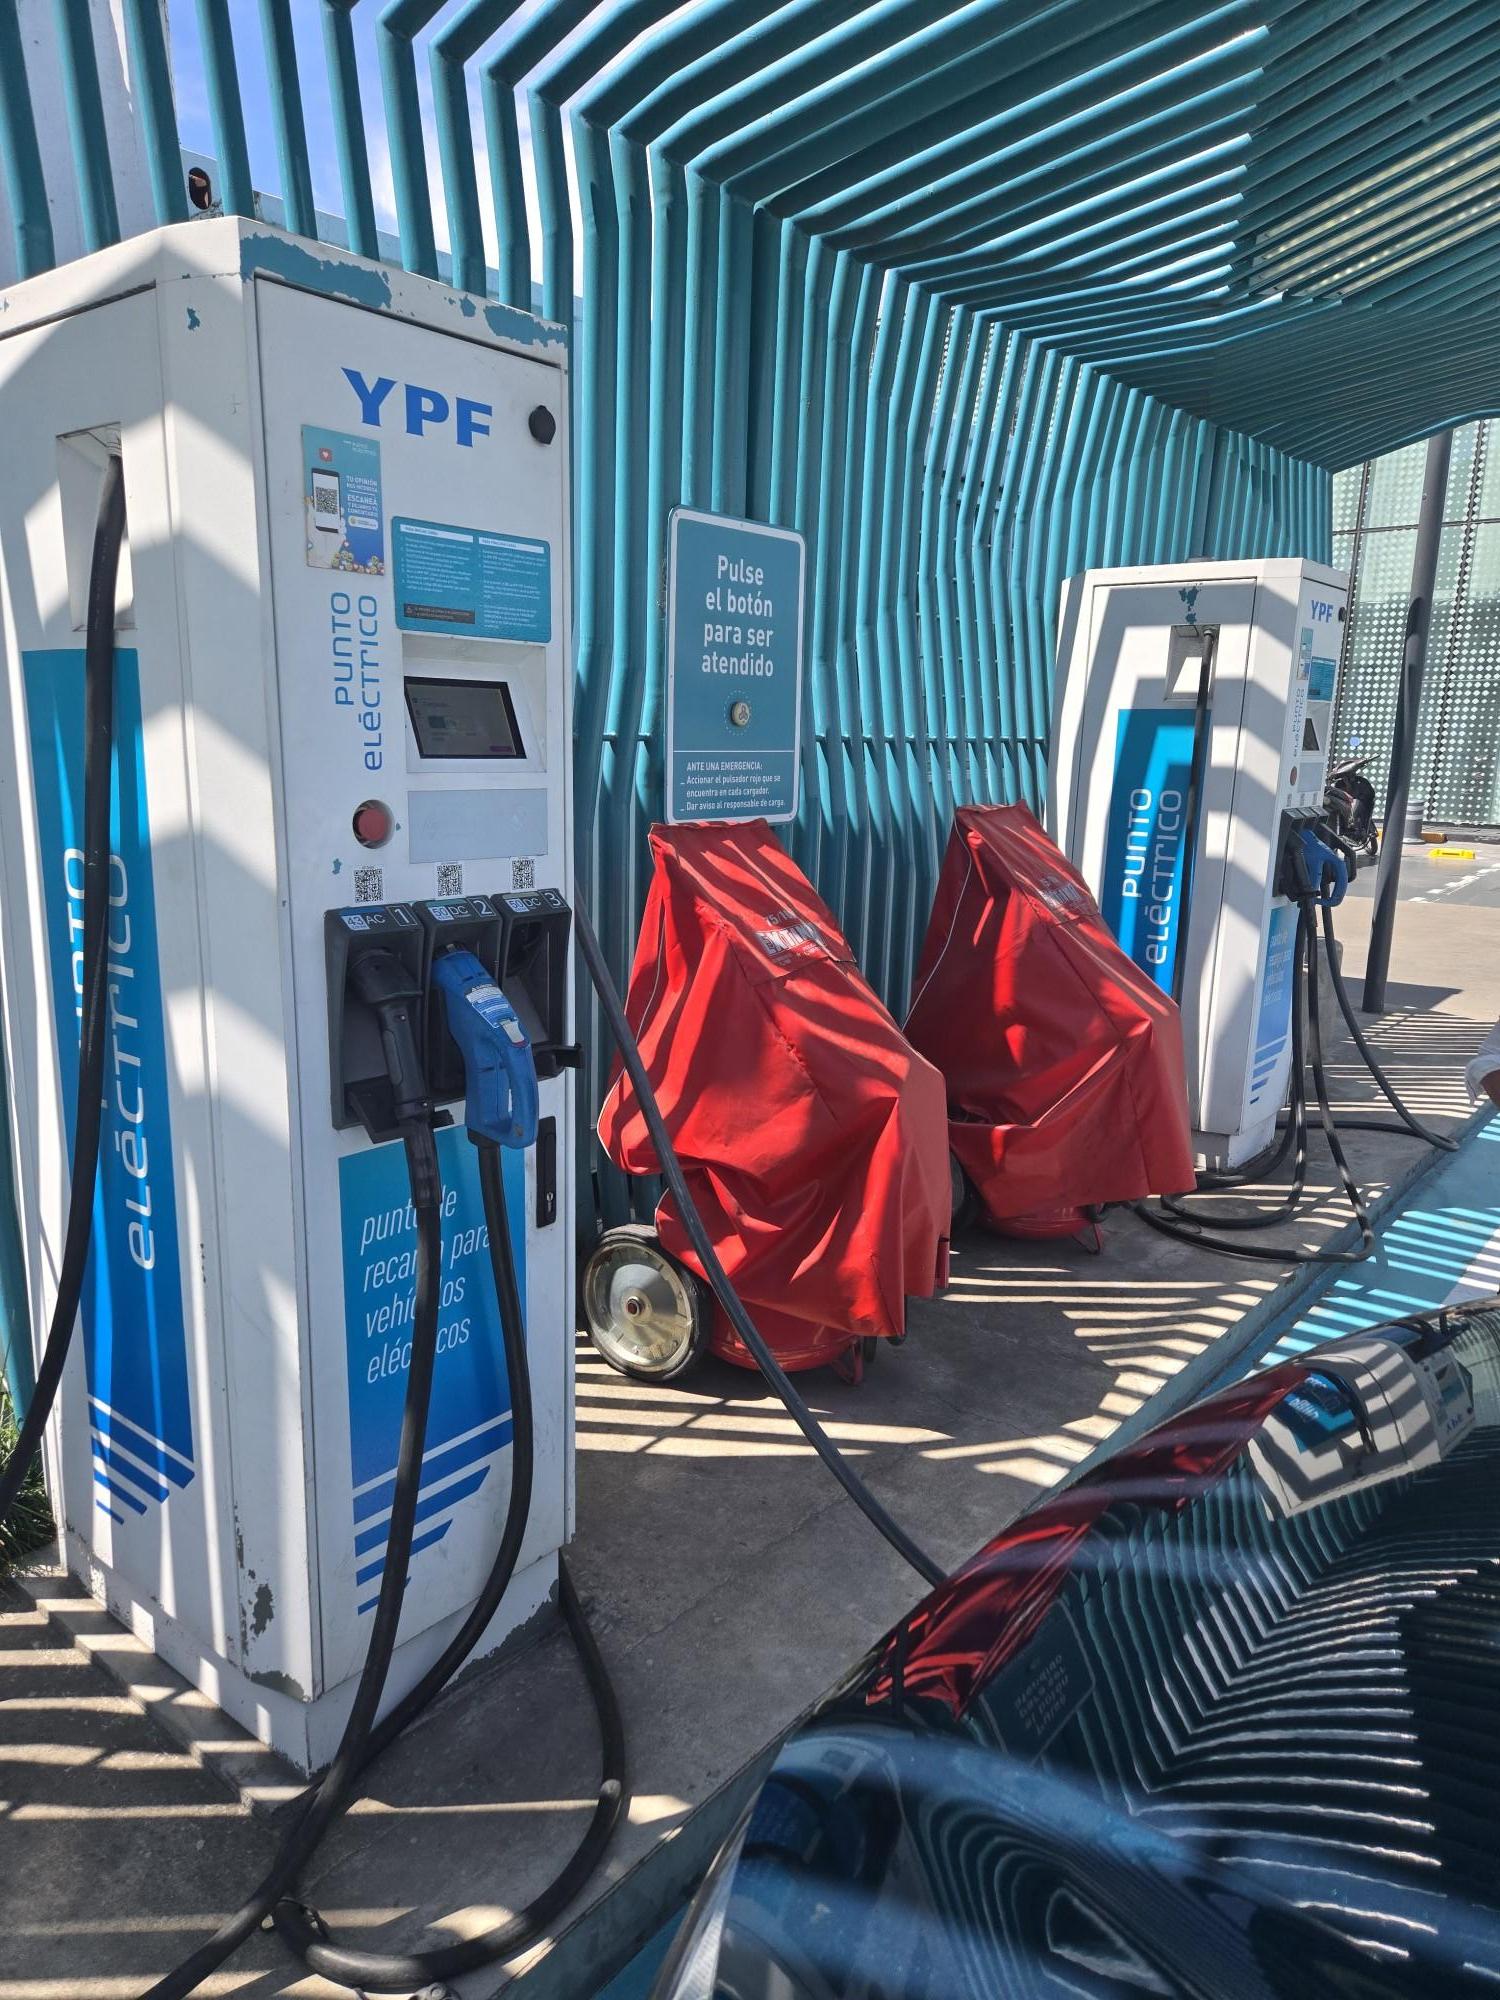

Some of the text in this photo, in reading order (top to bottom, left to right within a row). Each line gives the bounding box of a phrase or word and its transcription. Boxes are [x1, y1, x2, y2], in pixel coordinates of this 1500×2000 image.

[340, 367, 493, 448] YPF
[717, 555, 764, 585] Pulse
[705, 587, 773, 617] el botón
[1311, 600, 1334, 623] YPF
[703, 622, 774, 648] para ser
[702, 652, 774, 677] atendido
[686, 761, 705, 771] ANTE
[706, 762, 720, 771] UNA
[686, 776, 714, 785] Accionar
[715, 775, 721, 783] el
[722, 775, 749, 786] pulsador
[749, 775, 761, 785] rojo
[762, 775, 773, 784] que
[686, 788, 719, 798] encuentra
[727, 787, 742, 796] cada
[686, 802, 698, 811] Dar
[699, 801, 716, 811] aviso
[716, 801, 723, 809] al
[723, 799, 759, 811] responsable
[760, 799, 768, 807] de
[431, 907, 448, 917] 50
[448, 906, 469, 916] DC
[473, 900, 493, 915] 2
[508, 898, 524, 908] 50
[523, 897, 541, 907] DC
[544, 892, 561, 907] 3
[366, 914, 386, 924] AC
[394, 908, 410, 924] 1
[367, 1318, 471, 1384] eléccos
